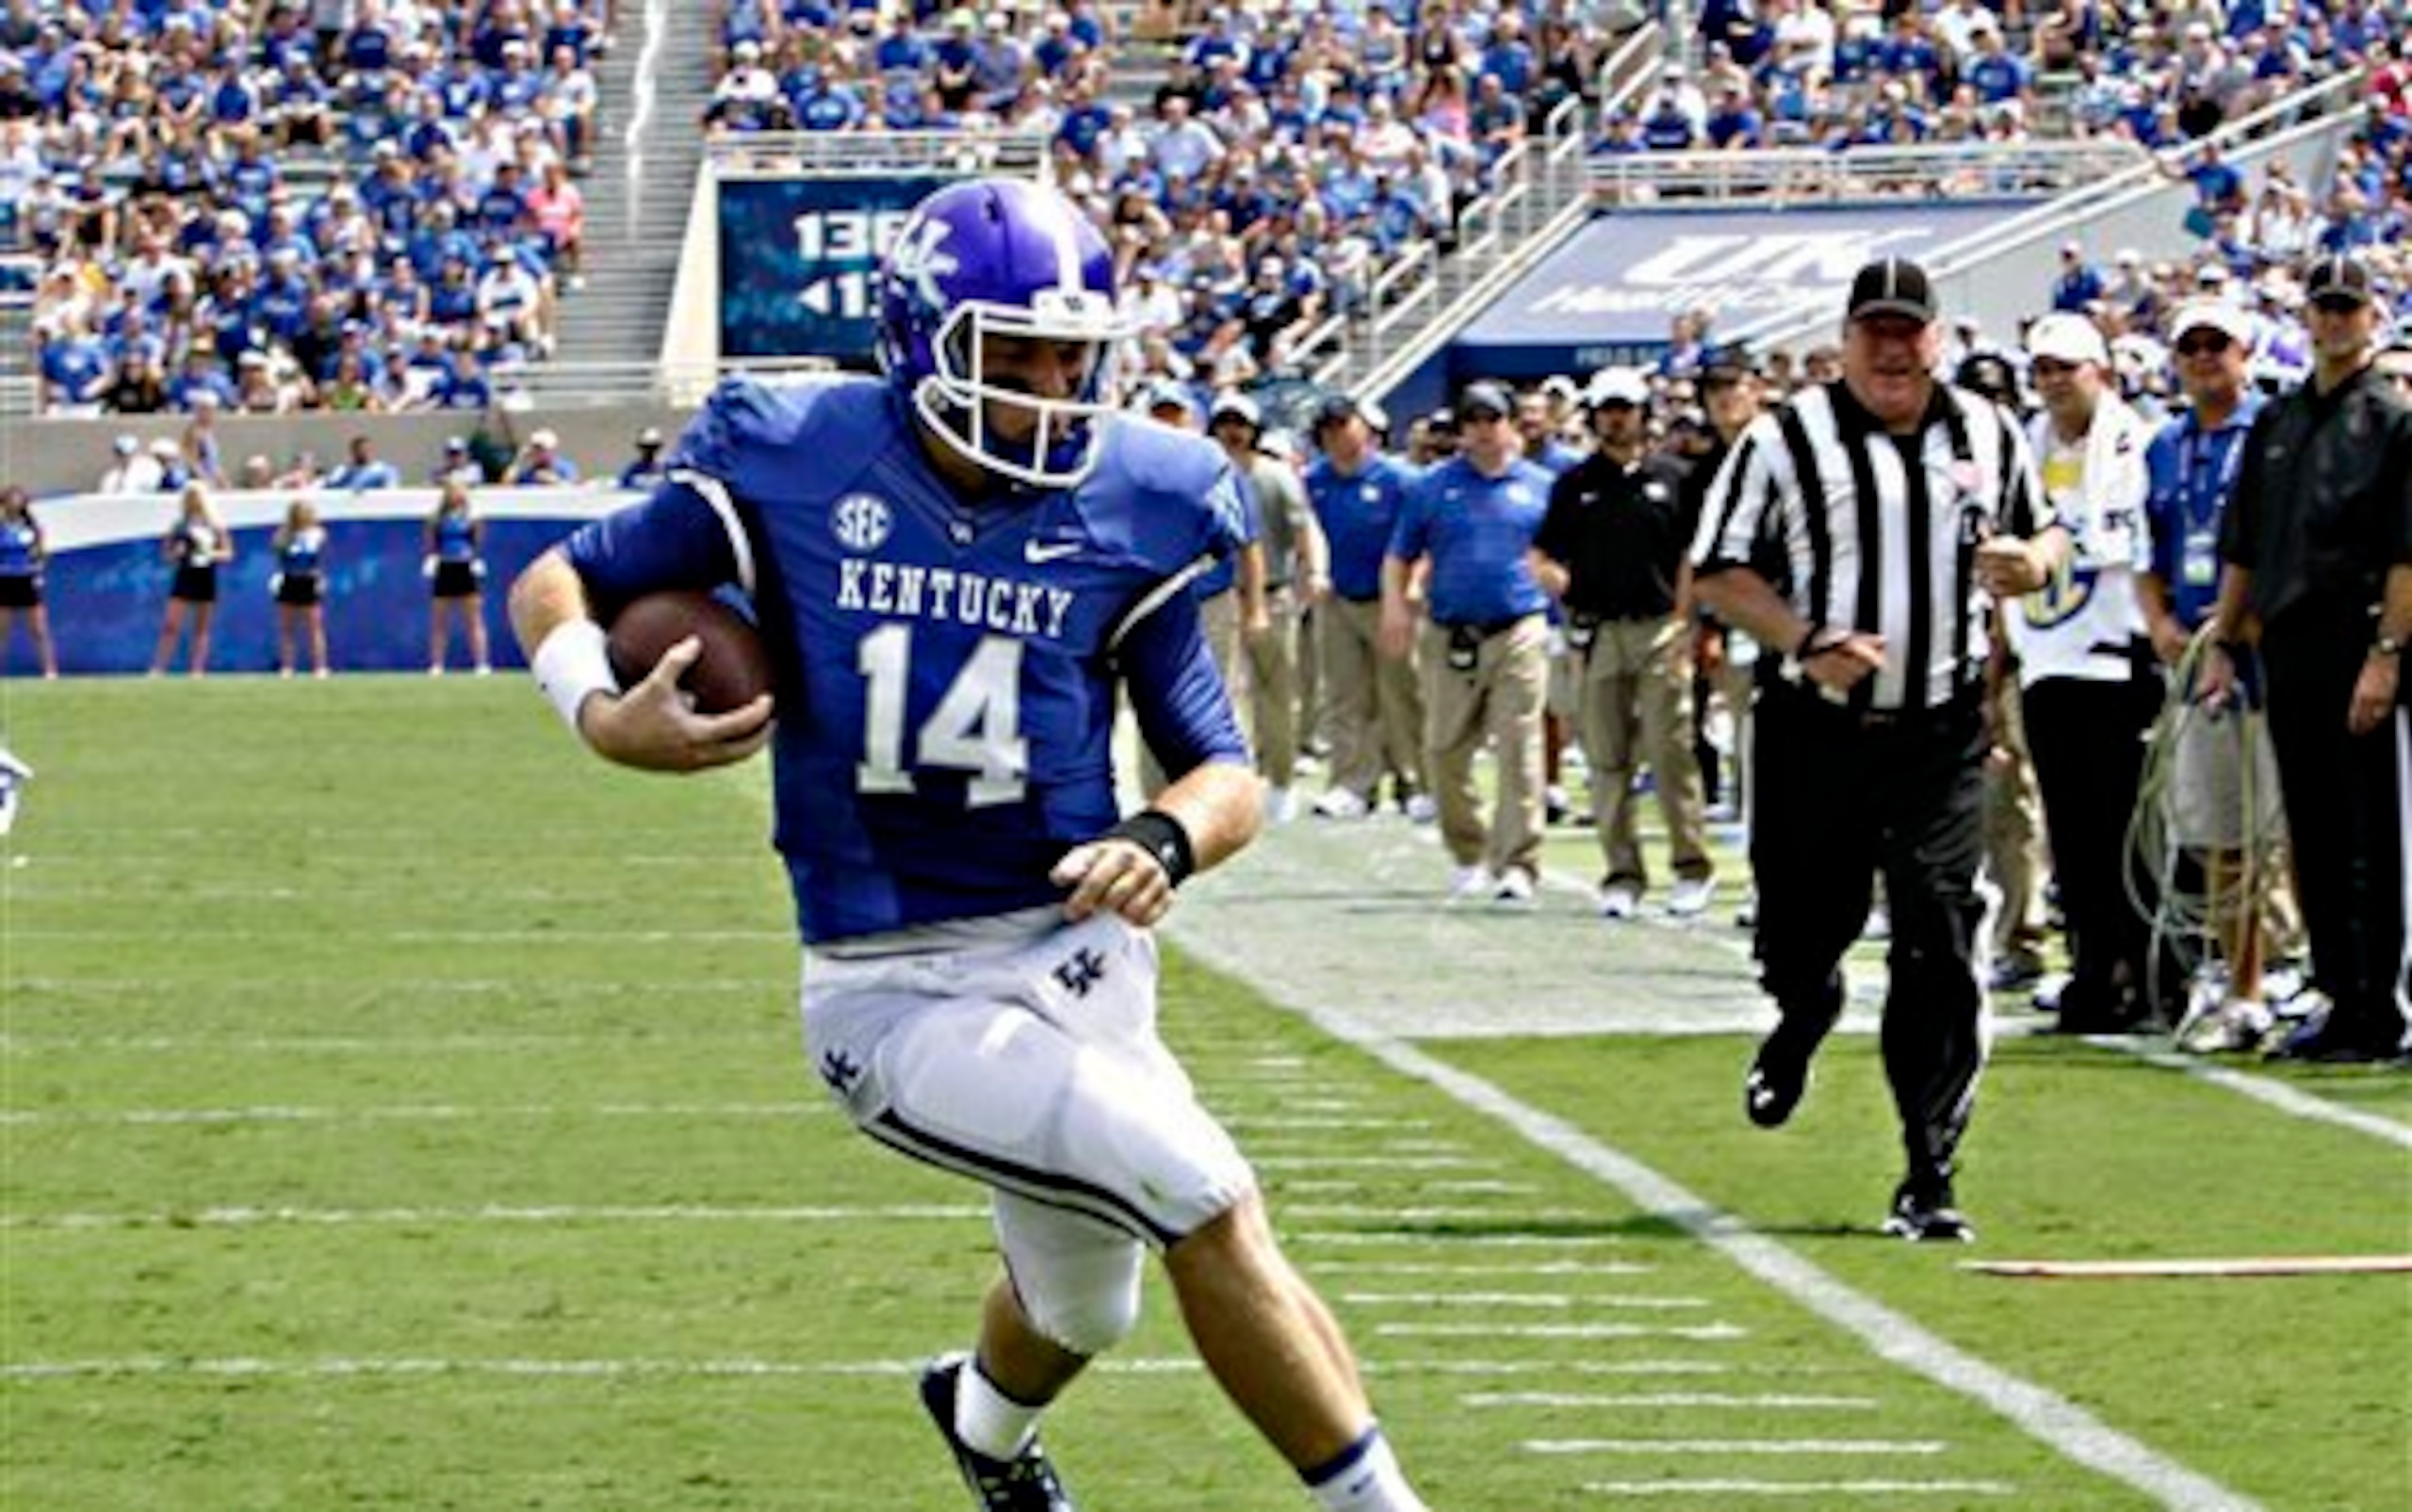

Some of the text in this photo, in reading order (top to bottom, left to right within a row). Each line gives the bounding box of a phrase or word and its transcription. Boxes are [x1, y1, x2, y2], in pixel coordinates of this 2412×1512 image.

[836, 496, 888, 548] SEC
[836, 559, 1075, 639] KENTUCKY
[856, 621, 1030, 808] 14
